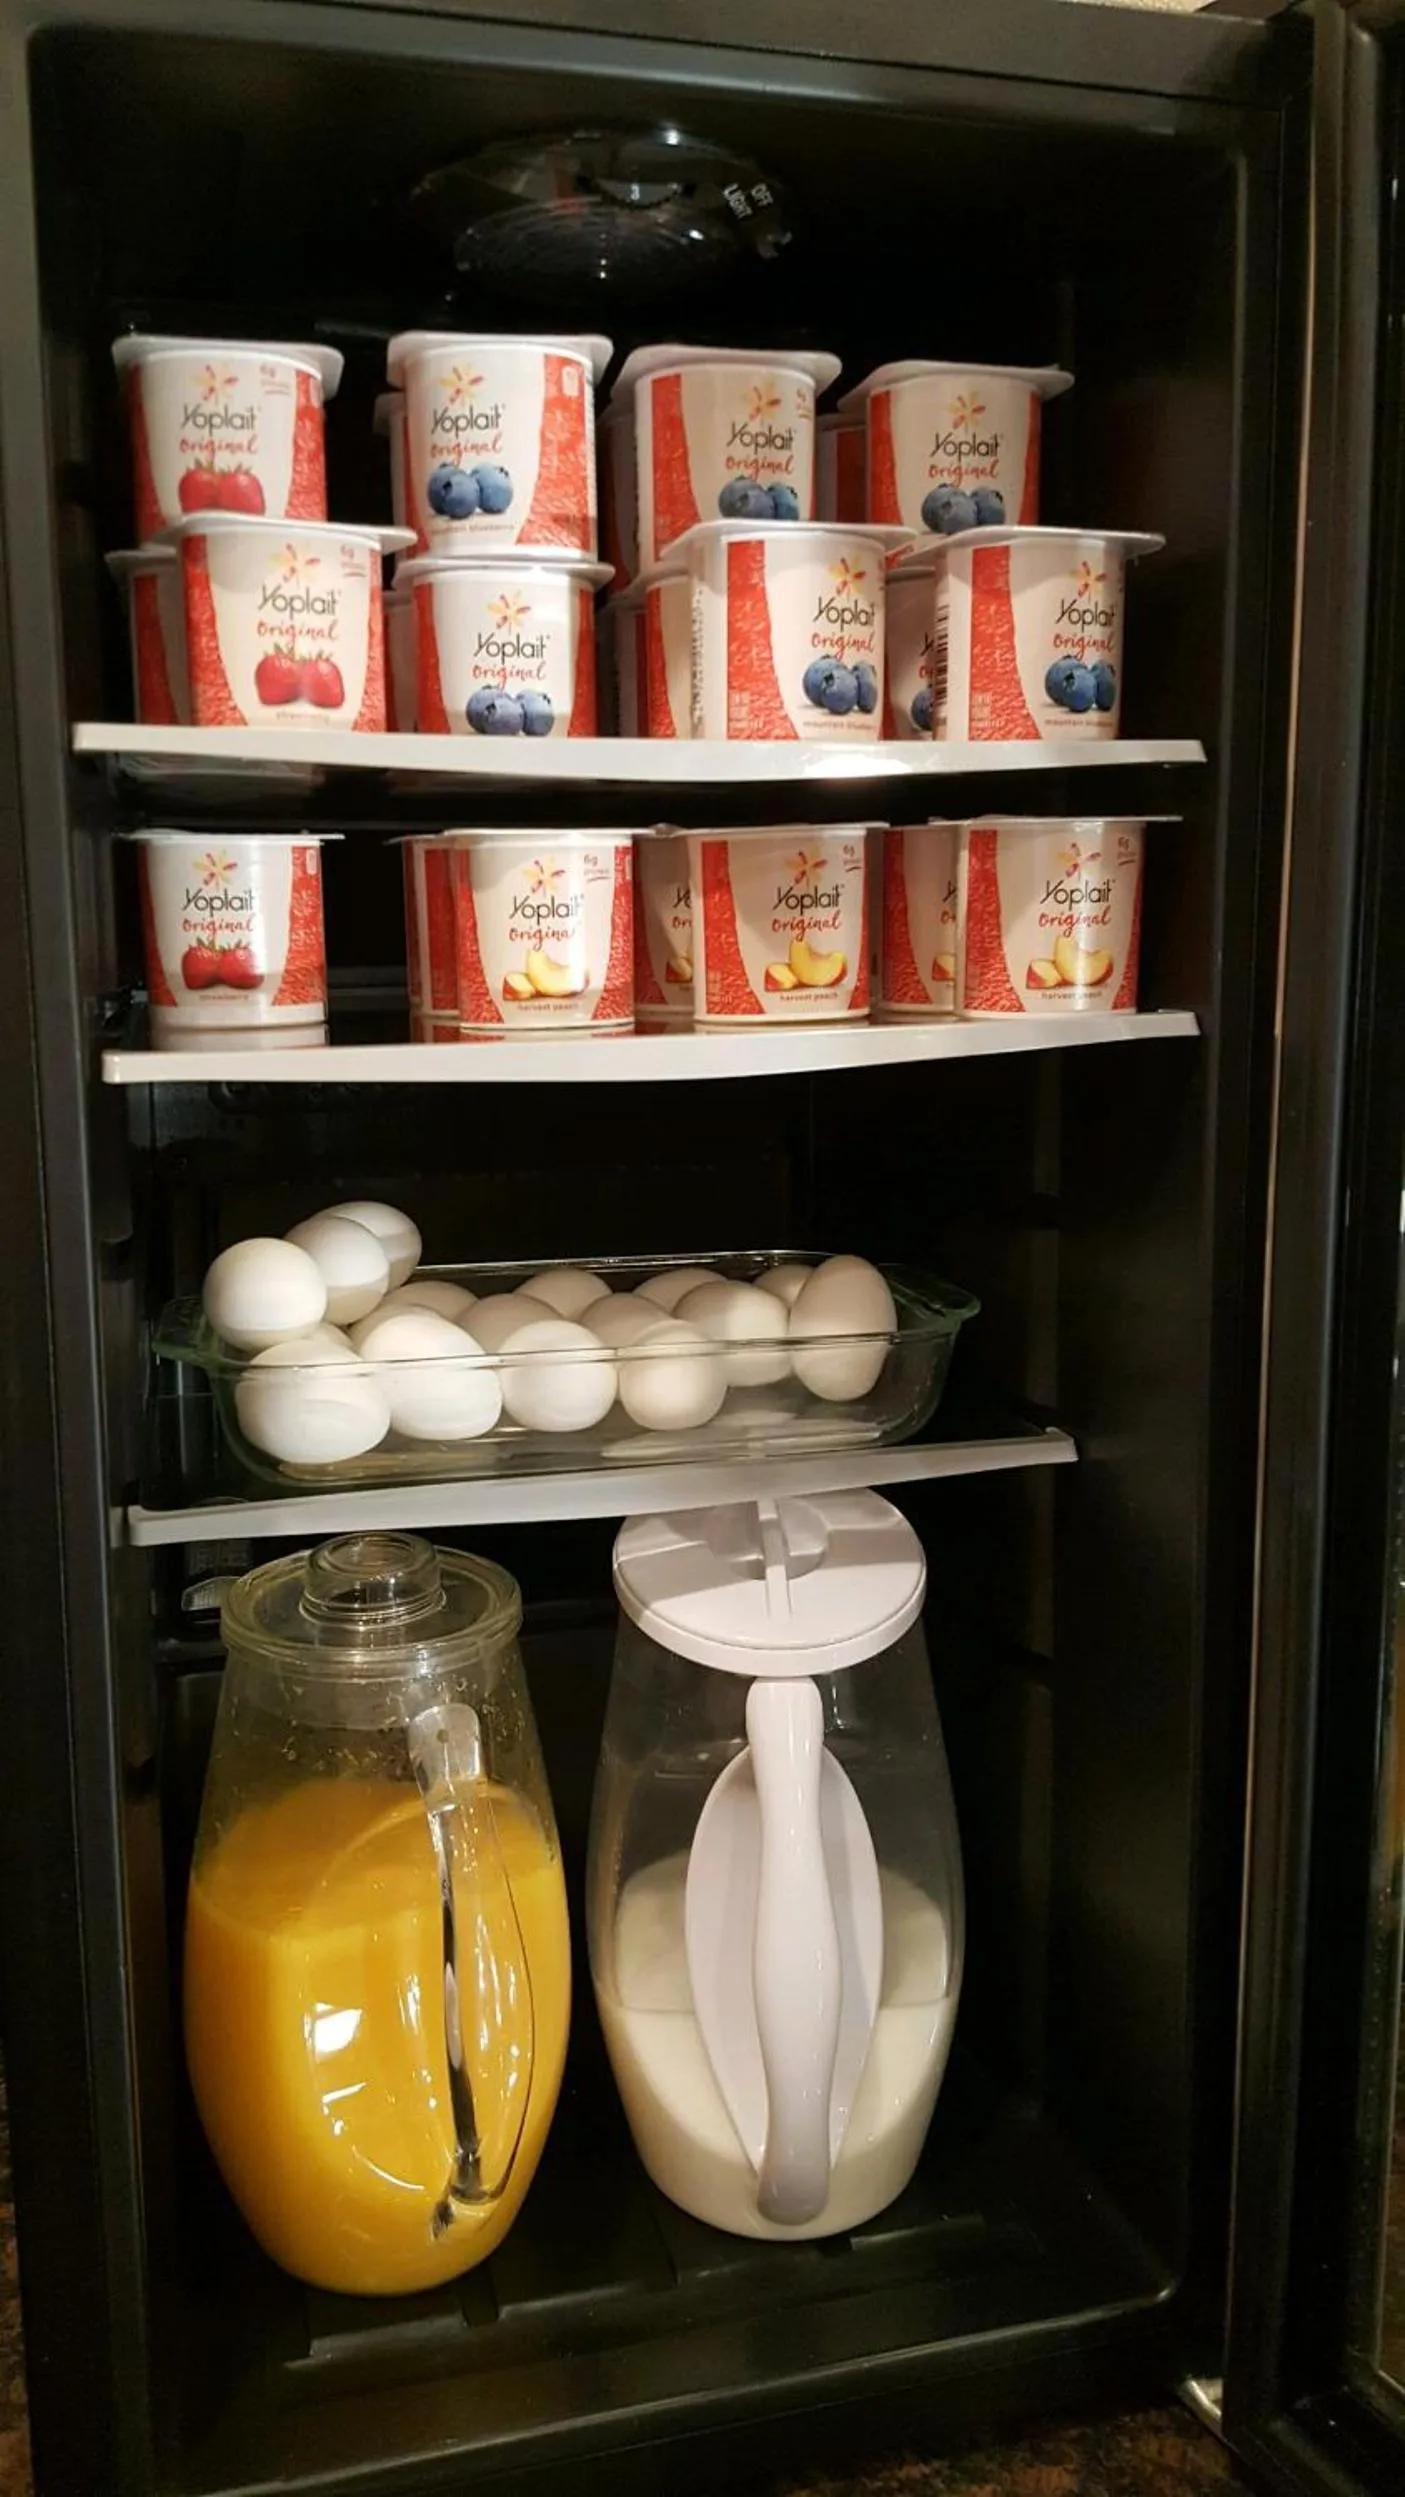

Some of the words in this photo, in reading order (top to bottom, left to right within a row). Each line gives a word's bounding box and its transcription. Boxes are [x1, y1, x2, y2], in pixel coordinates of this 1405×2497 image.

[750, 182, 774, 207] OFF
[181, 403, 257, 437] Yoplait
[431, 404, 501, 439] Yoplait
[726, 421, 794, 455] Yoplait
[929, 432, 999, 464] Yoplait
[258, 584, 337, 621] Yoplait
[813, 596, 876, 631] Yoplait
[473, 632, 547, 665] Yoplait
[182, 888, 254, 918] Yoplait
[509, 896, 580, 926] Yoplait
[772, 884, 841, 915] Yoplait
[1040, 879, 1113, 911] Yoplait
